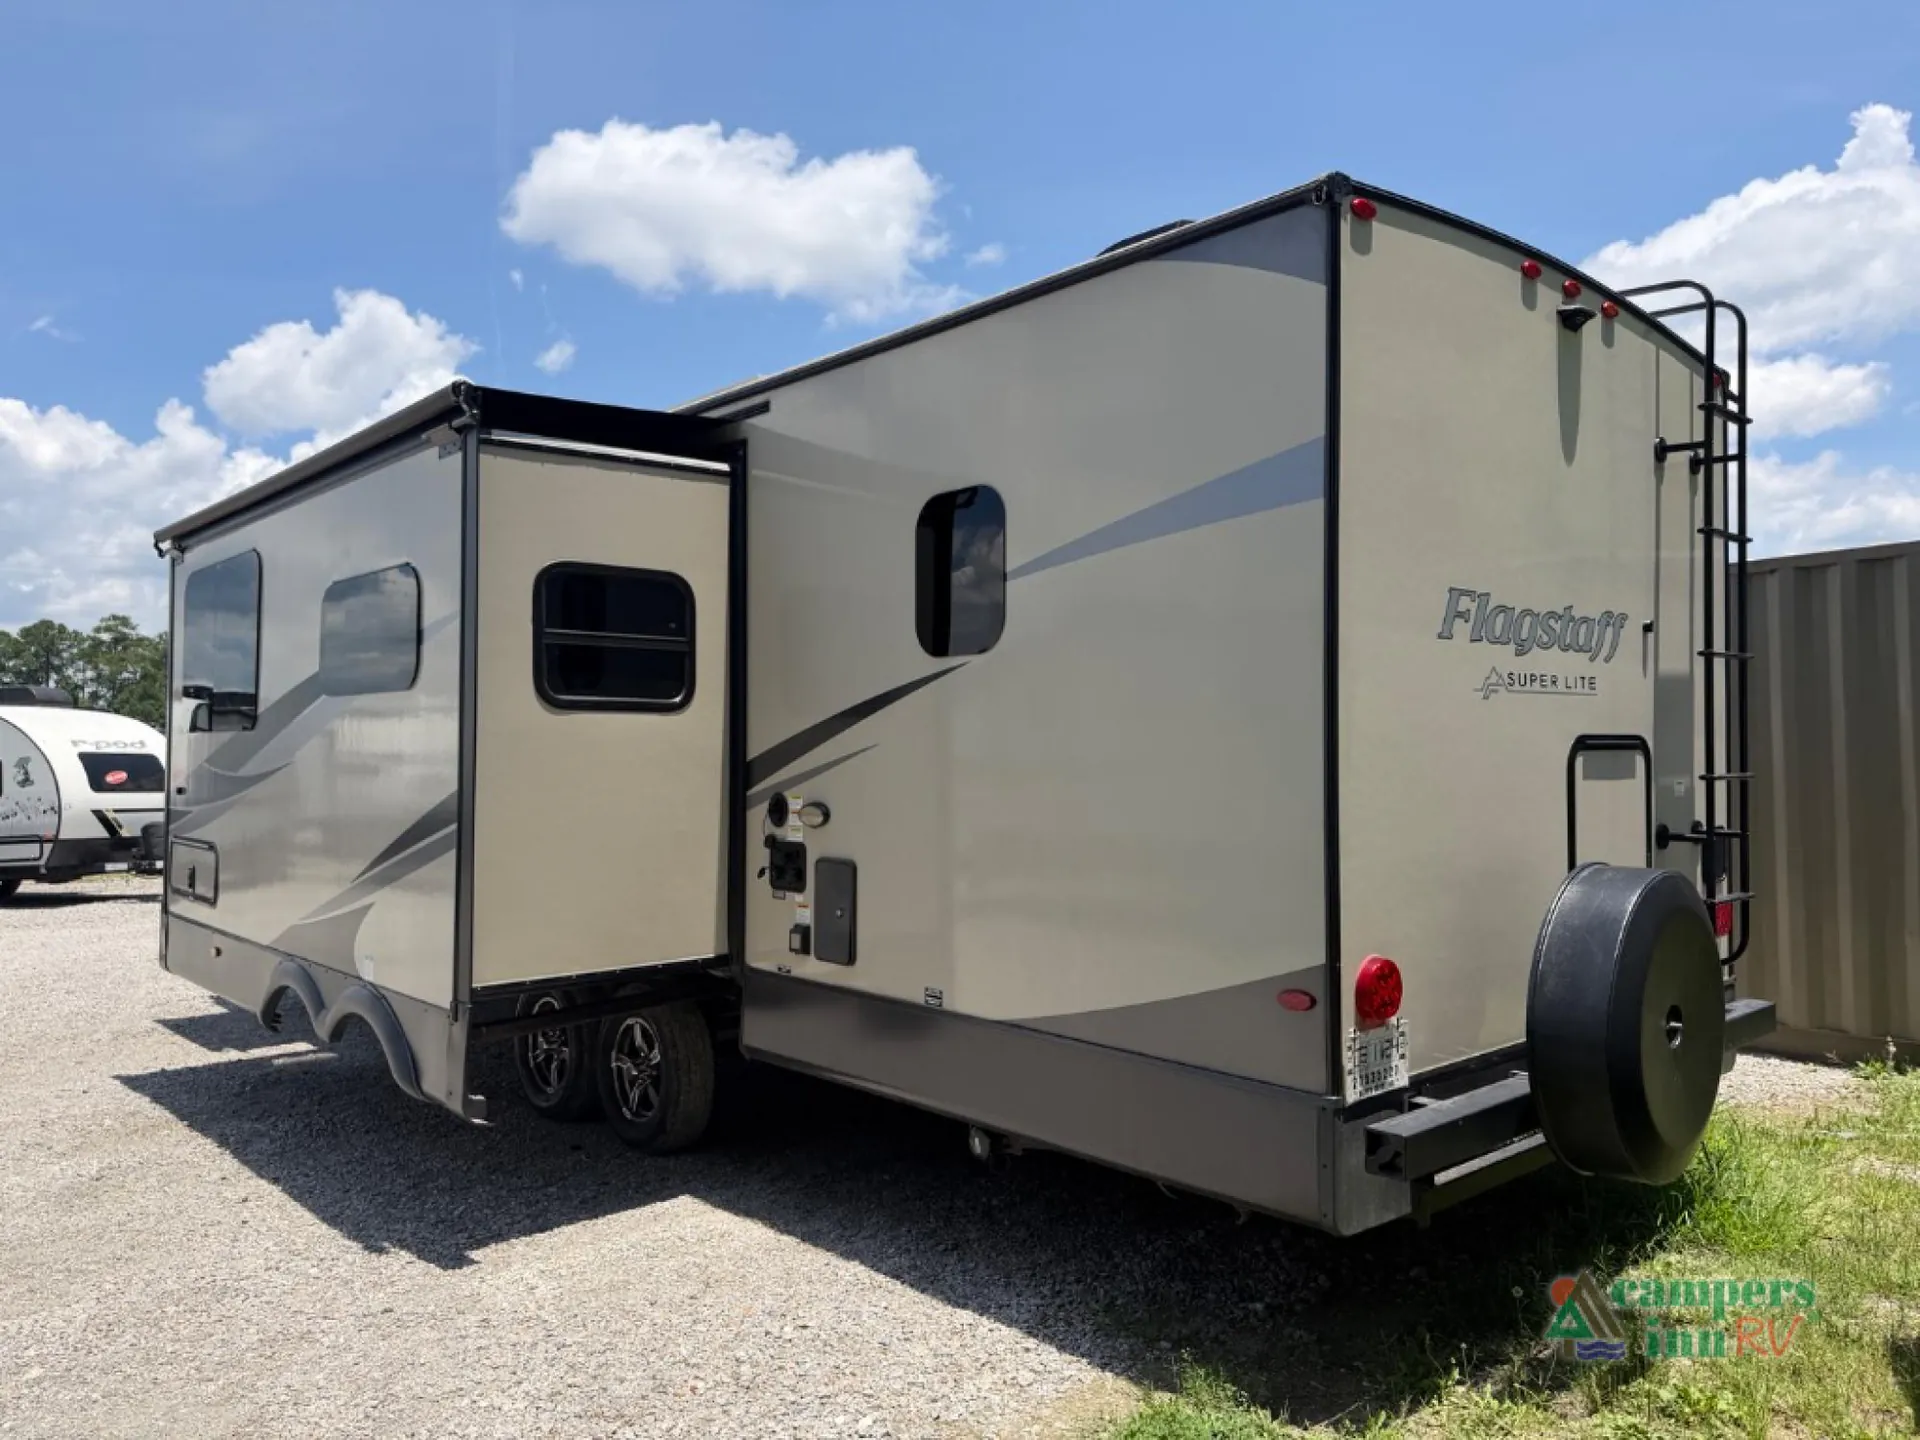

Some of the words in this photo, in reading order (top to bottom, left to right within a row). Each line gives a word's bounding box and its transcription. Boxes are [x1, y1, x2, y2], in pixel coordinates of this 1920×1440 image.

[1437, 586, 1629, 664] Flagstaff
[1506, 672, 1559, 689] SUPER
[1565, 675, 1597, 691] LITE
